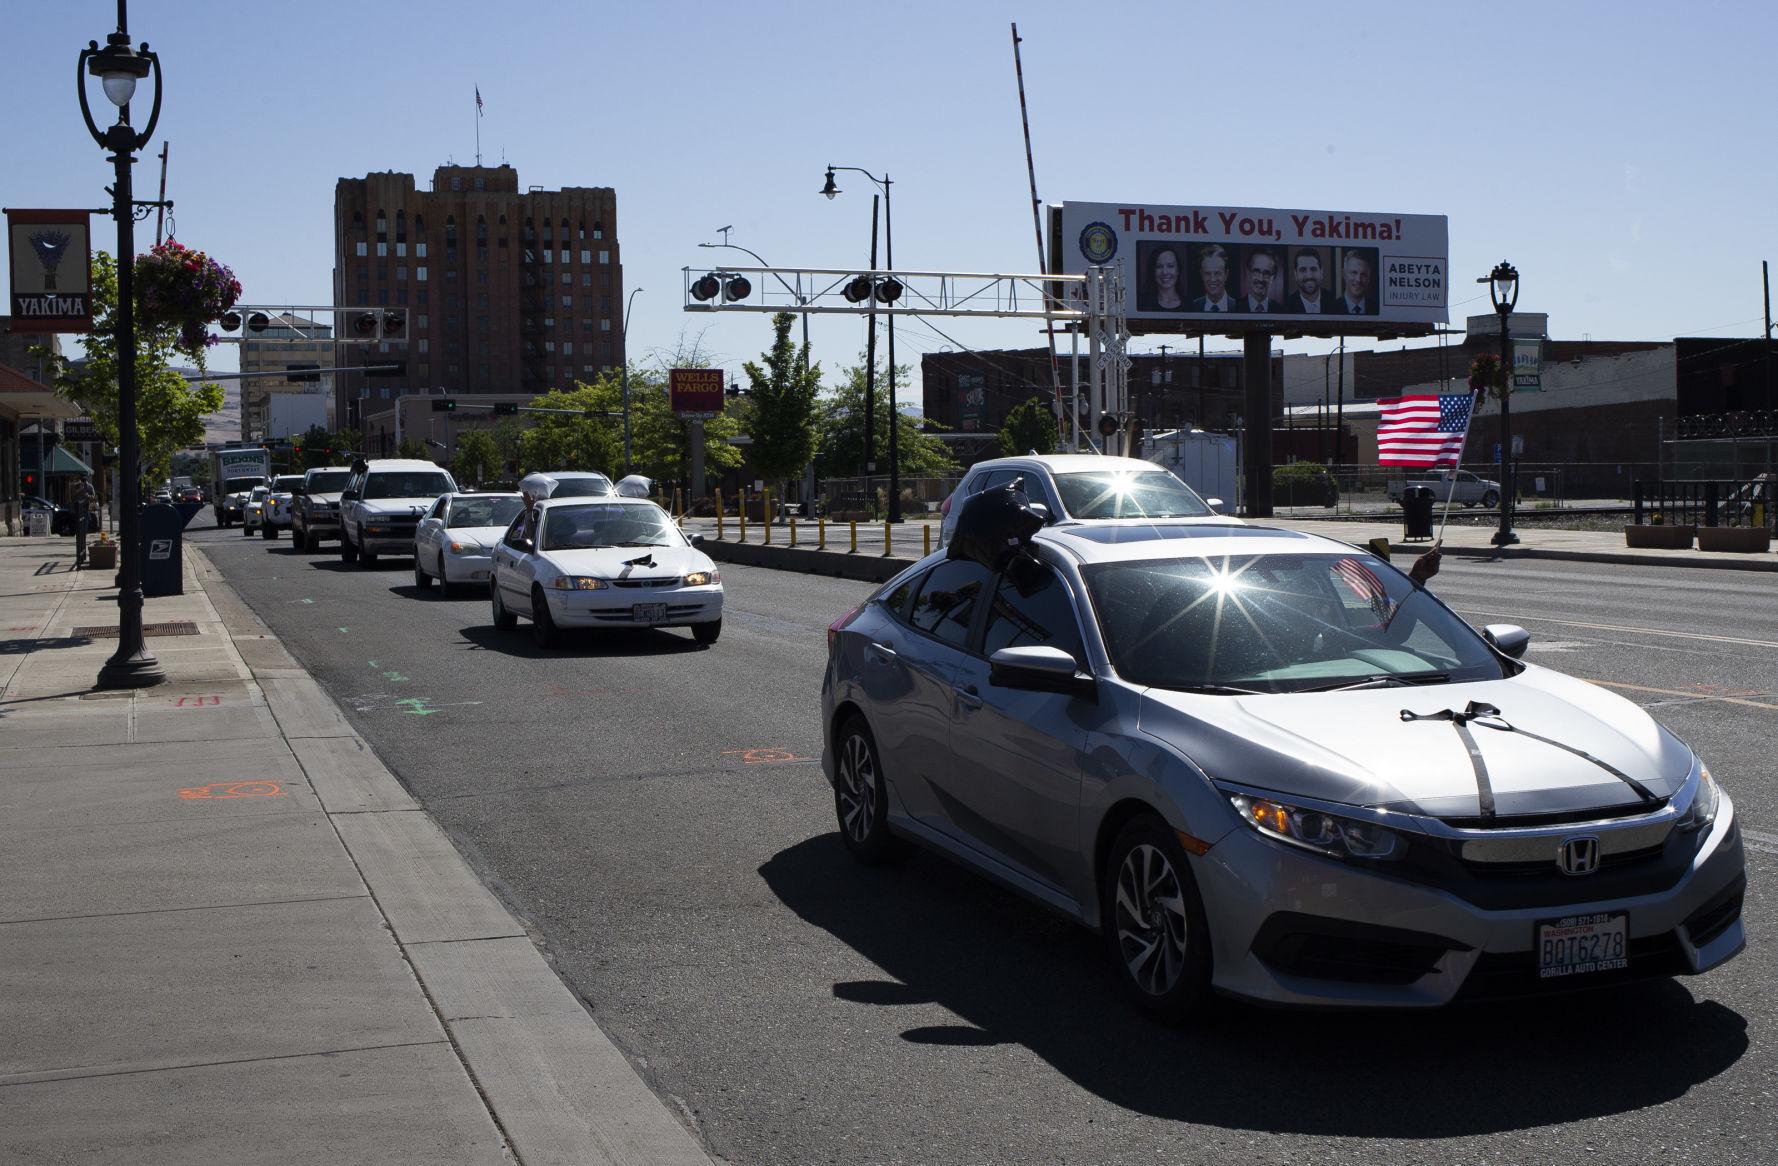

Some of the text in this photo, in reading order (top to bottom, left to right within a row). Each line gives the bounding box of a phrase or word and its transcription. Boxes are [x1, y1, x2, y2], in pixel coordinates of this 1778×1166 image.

[1118, 208, 1402, 241] Thank You, Yakima!
[1389, 263, 1440, 275] ABEYTA
[1389, 277, 1440, 288] NELSON
[1389, 291, 1440, 301] INJURY LAW
[18, 297, 85, 316] YAKIMA
[675, 372, 719, 383] WELLS
[1515, 375, 1538, 385] YAKIMA
[676, 383, 719, 393] FARGO
[1544, 926, 1594, 938] WASHINGTON
[1540, 958, 1628, 978] GORILLA AUTO CENTER
